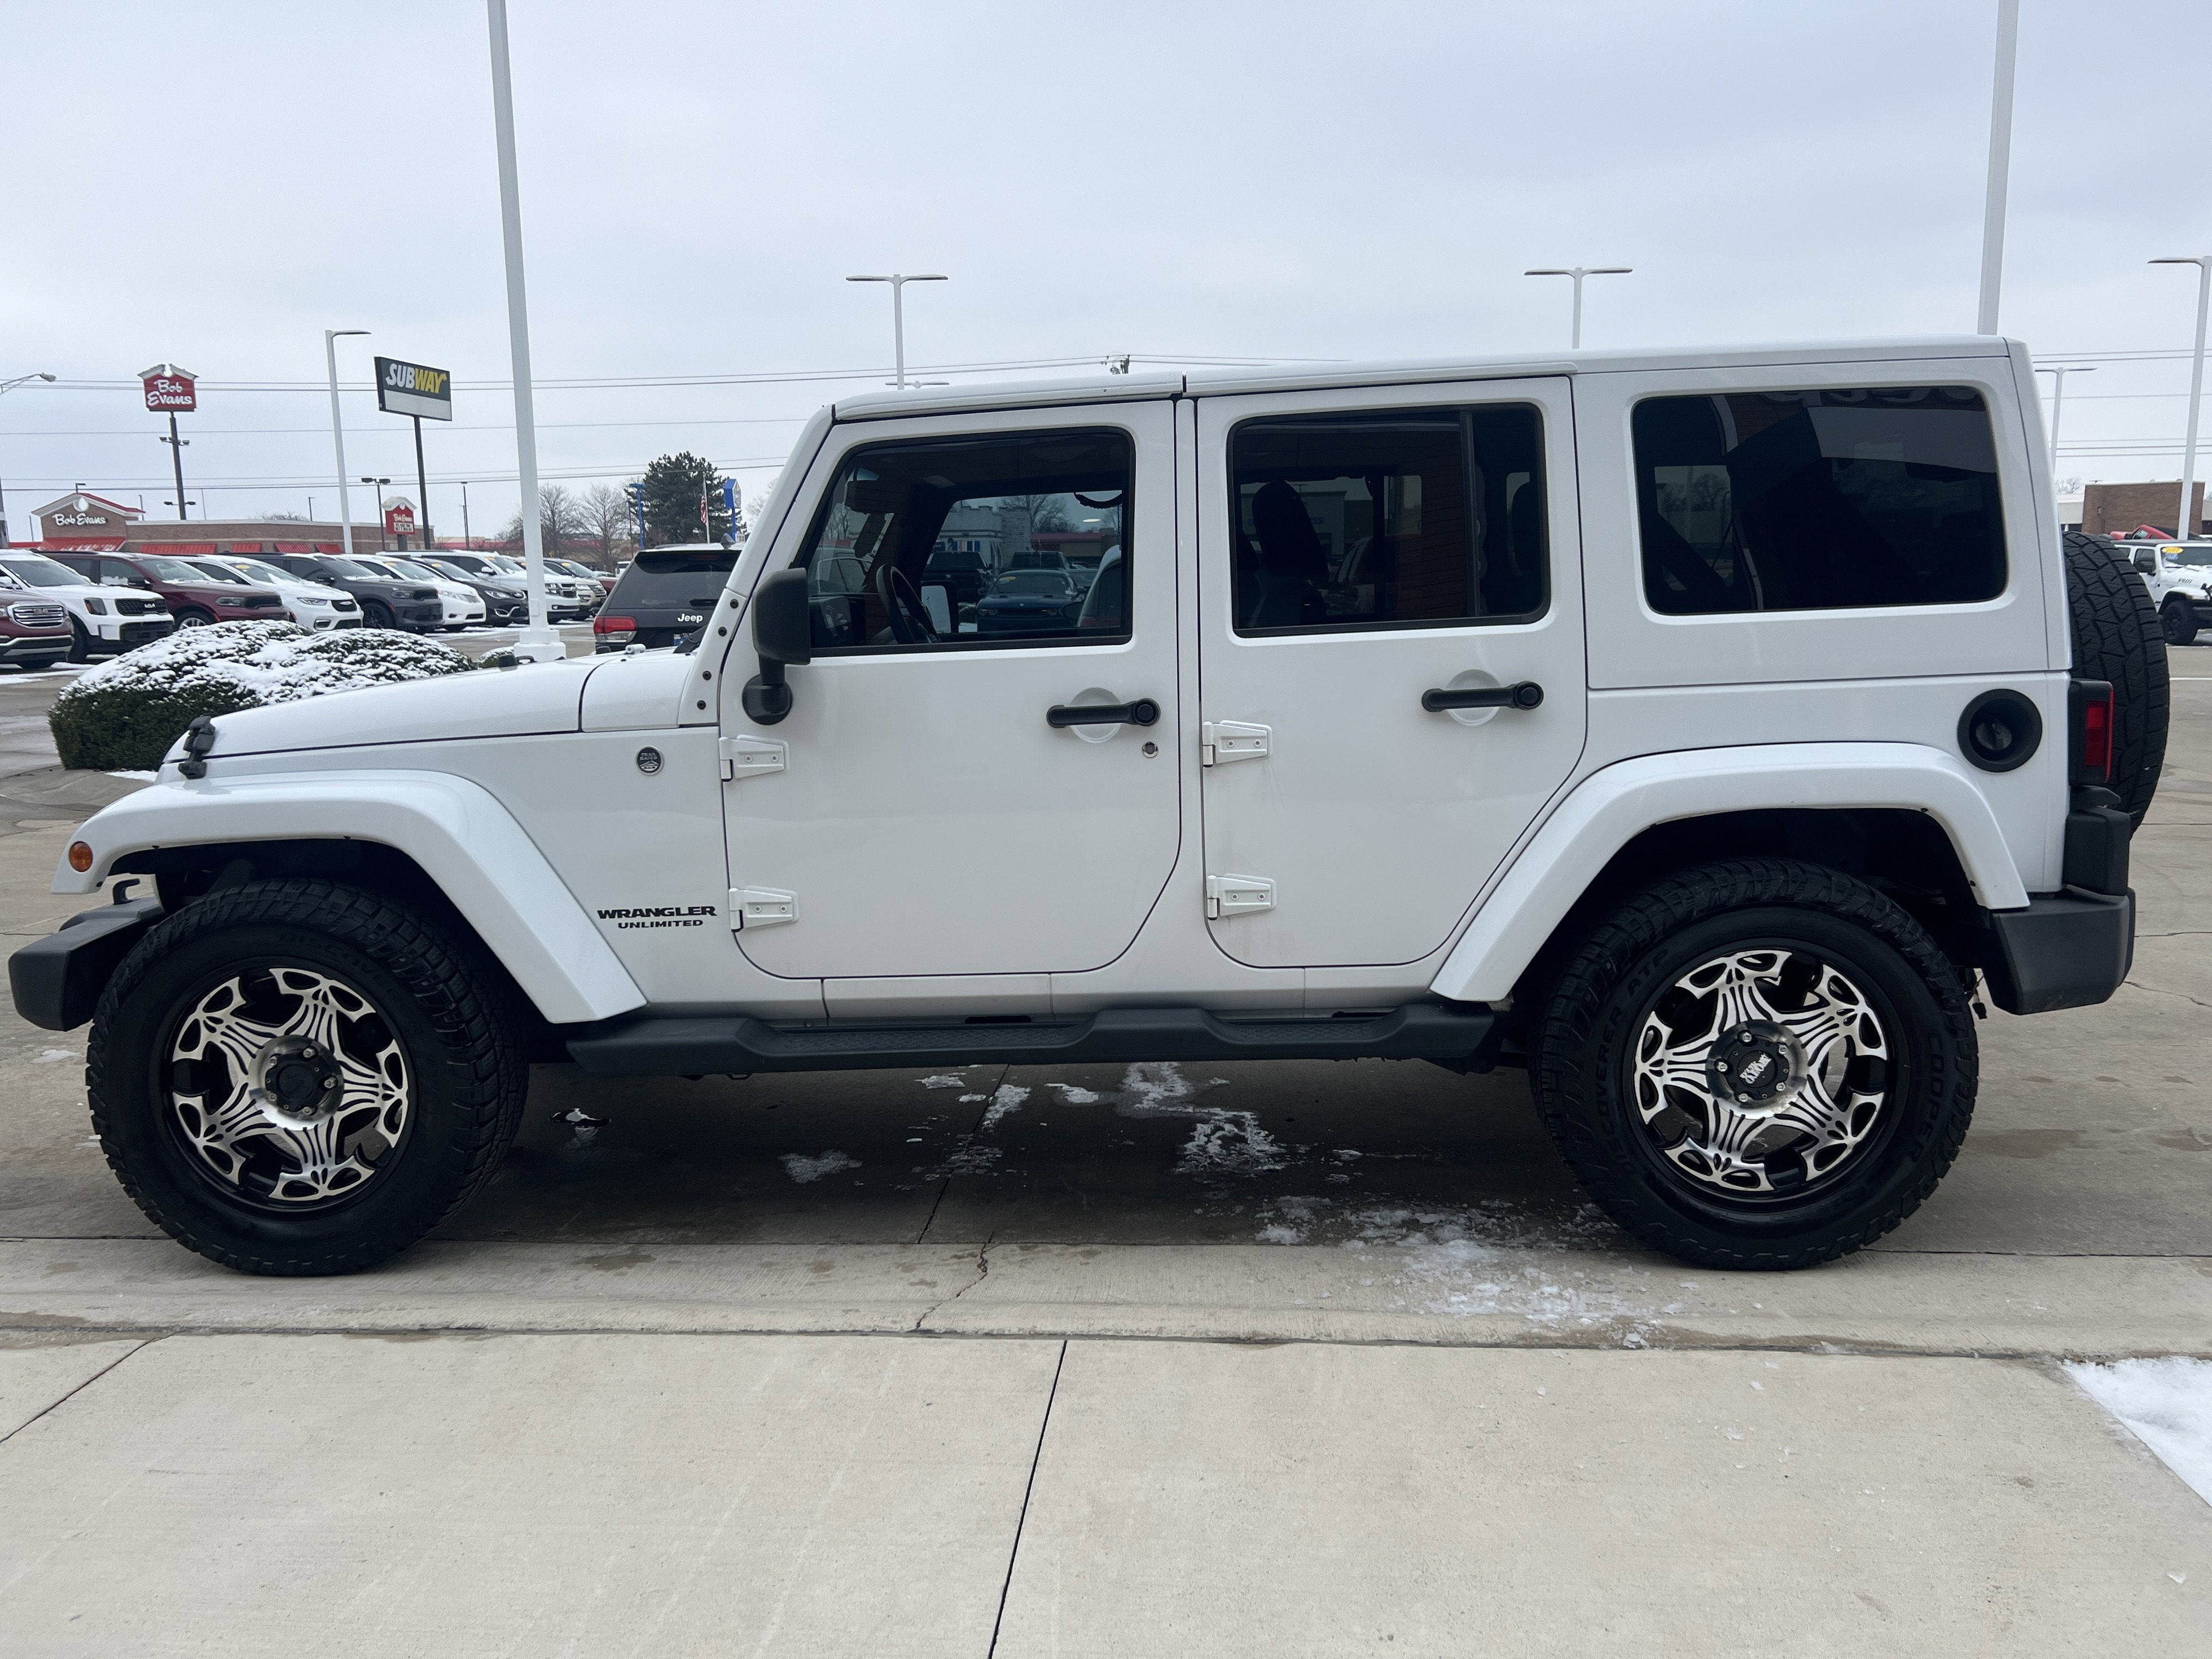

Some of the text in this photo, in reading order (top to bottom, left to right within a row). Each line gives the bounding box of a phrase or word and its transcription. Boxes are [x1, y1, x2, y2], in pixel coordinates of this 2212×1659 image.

[385, 363, 447, 394] SUBWAY
[154, 379, 183, 393] Bob
[146, 391, 193, 406] Evans
[52, 512, 106, 526] Bob Evans
[677, 613, 703, 624] Jeep
[597, 906, 718, 919] WRANGLER
[618, 919, 704, 929] UNLIMITED
[1627, 948, 1669, 997] ATP
[1906, 1032, 1945, 1163] COOPER
